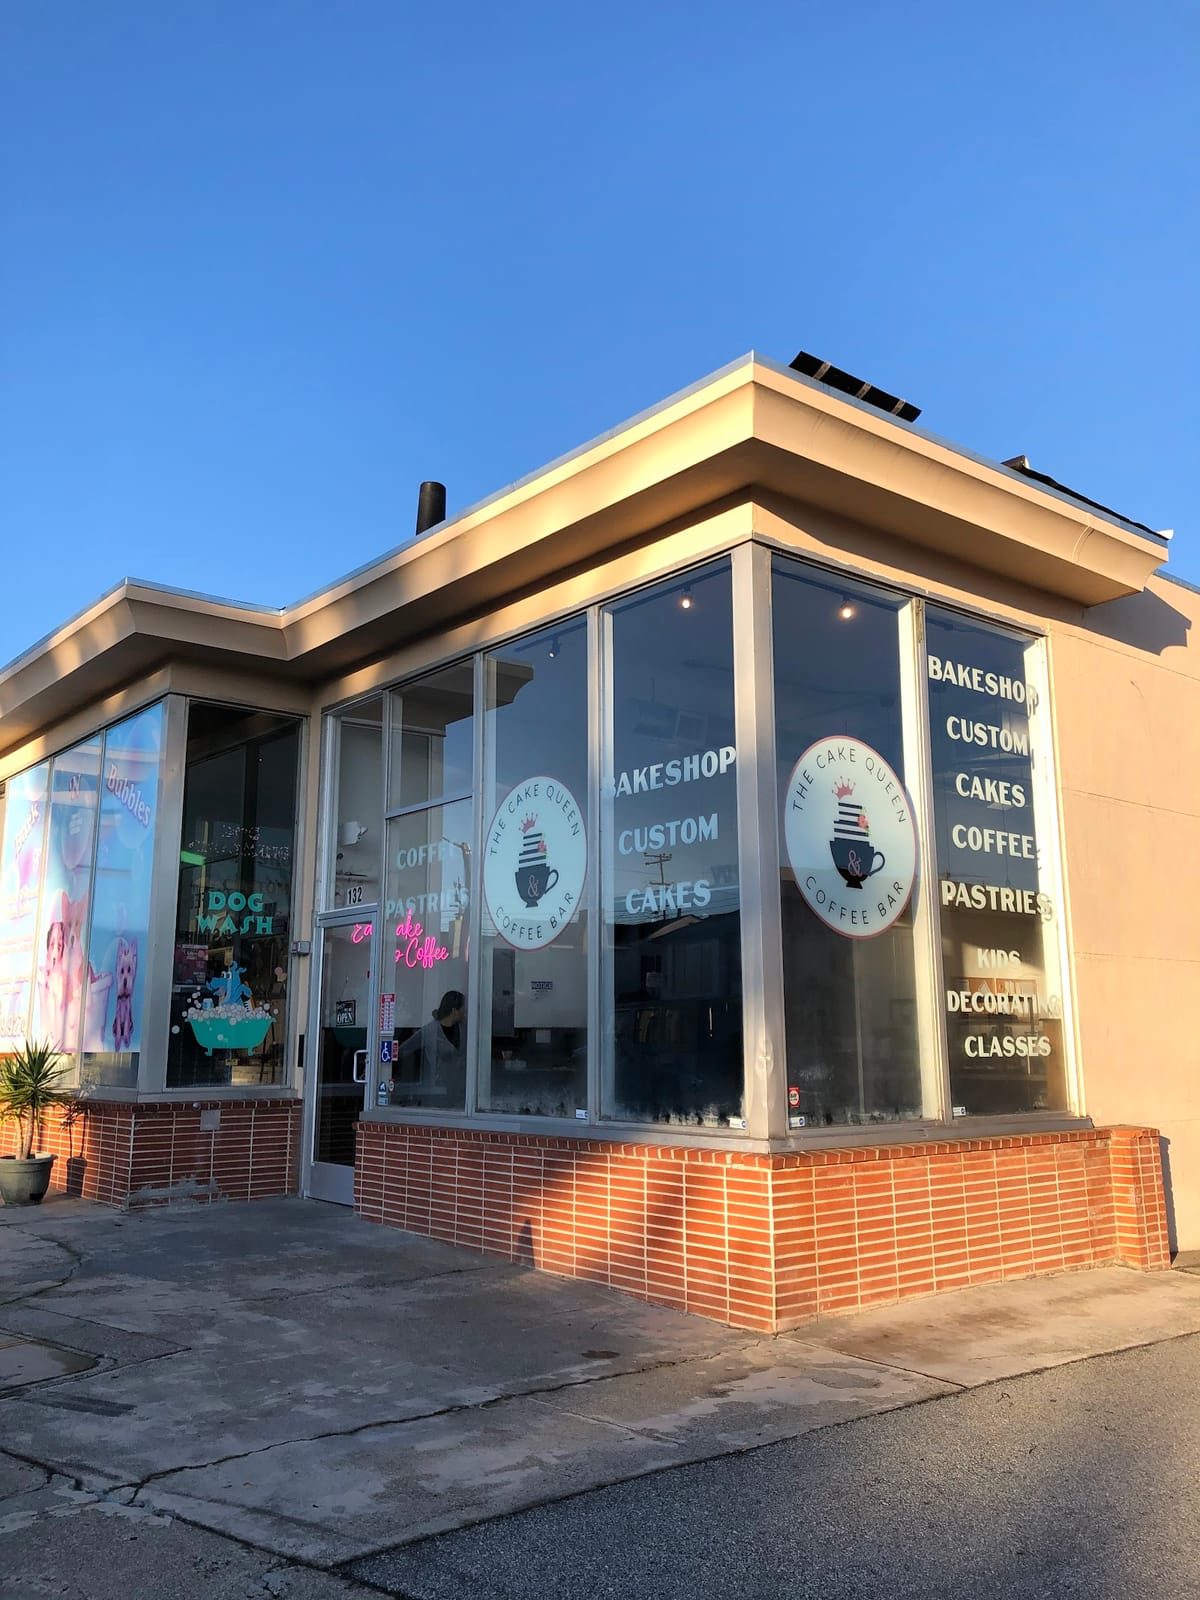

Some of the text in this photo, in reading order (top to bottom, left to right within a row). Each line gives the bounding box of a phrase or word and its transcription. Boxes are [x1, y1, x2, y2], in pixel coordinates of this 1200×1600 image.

[928, 655, 1036, 705] BAKESHOP
[946, 715, 1029, 756] CUSTOM
[601, 746, 736, 798] BAKESHOP
[793, 747, 907, 823] THE CAKE QUEEN
[956, 772, 1026, 808] CAKES
[106, 764, 151, 828] Bubbles
[490, 784, 580, 856] THE CAKE QUEEN
[618, 813, 719, 855] CUSTOM
[952, 824, 1035, 859] COFFEE
[848, 850, 863, 876] &
[208, 891, 264, 913] DOG
[348, 887, 362, 904] 132
[528, 874, 540, 898] &
[625, 879, 712, 914] CAKES
[806, 876, 904, 925] COFFEE BAR
[941, 880, 1049, 916] PASTRIES
[196, 914, 274, 935] WASH
[351, 908, 423, 944] Ea ake
[496, 892, 574, 941] COFFEE BAR
[405, 936, 449, 968] Coffee
[977, 947, 1022, 969] KIDS
[965, 1036, 1051, 1057] CLASSES
